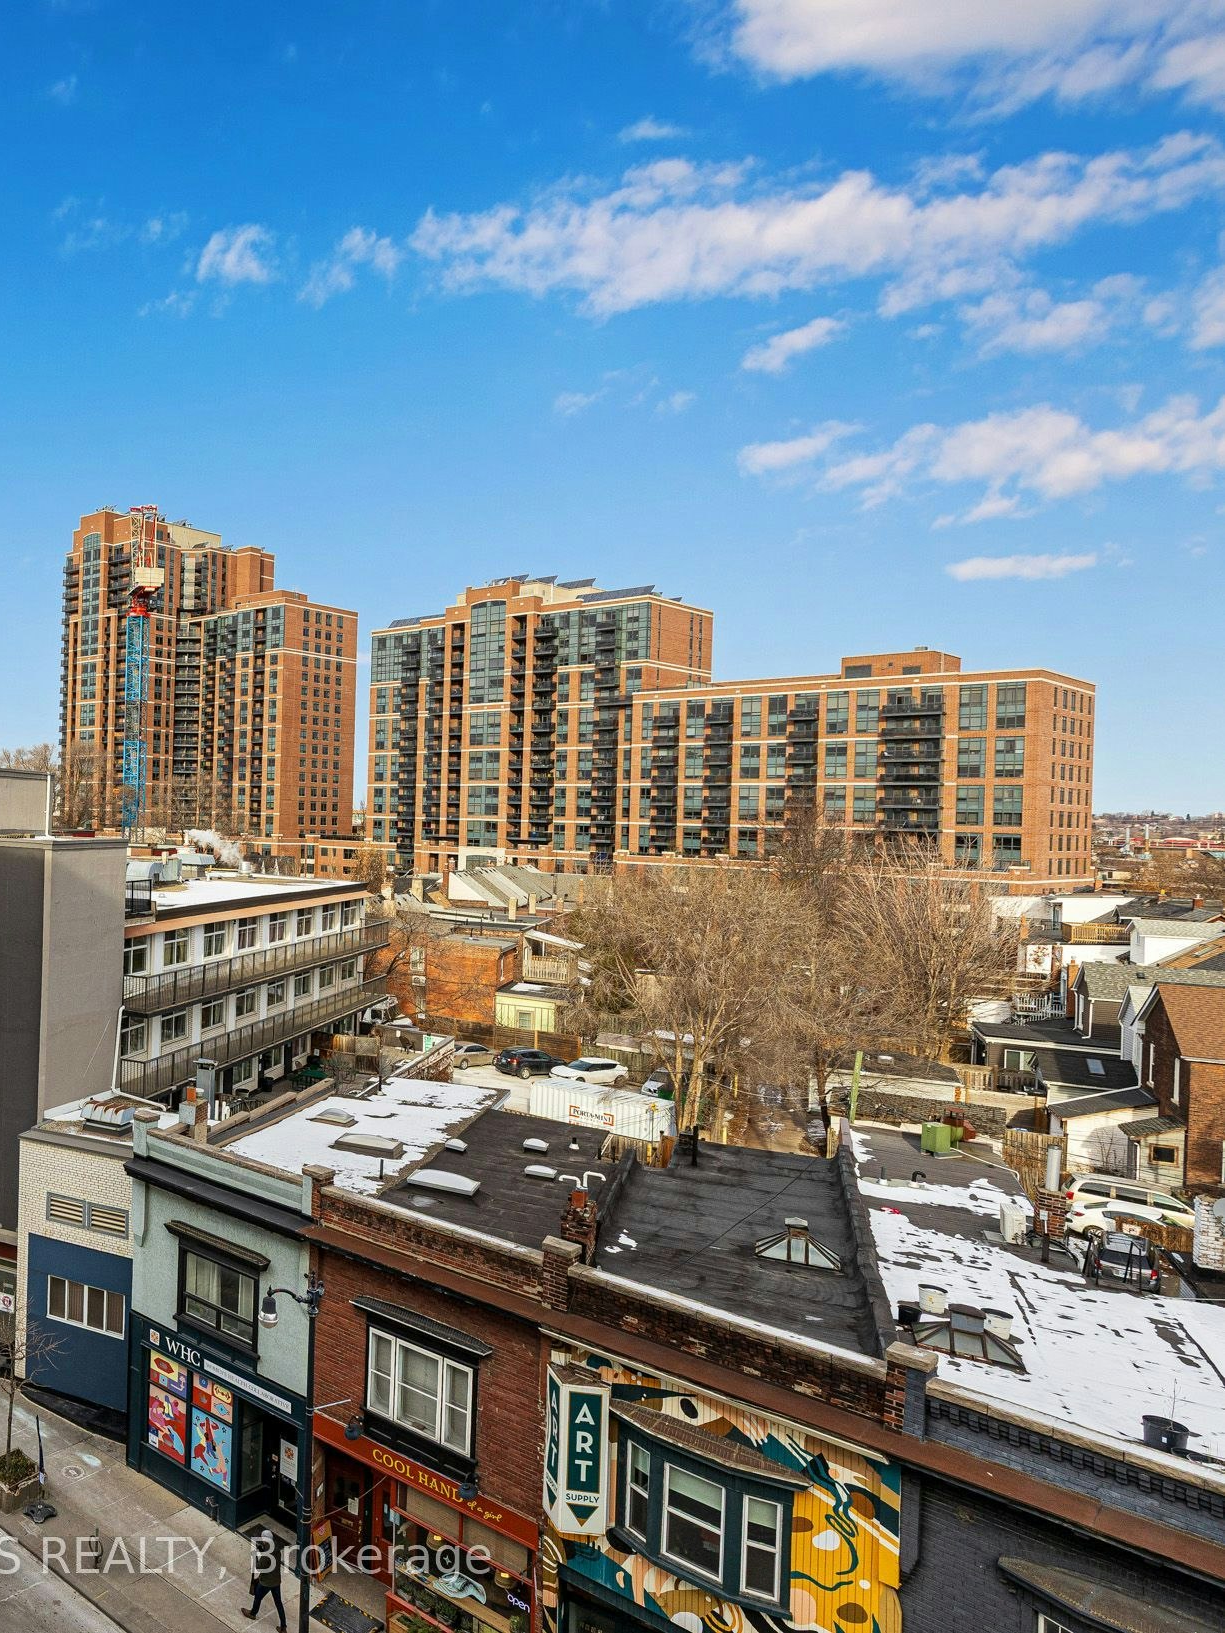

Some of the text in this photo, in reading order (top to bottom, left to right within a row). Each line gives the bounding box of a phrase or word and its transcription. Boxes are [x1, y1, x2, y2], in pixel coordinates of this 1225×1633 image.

[165, 1336, 201, 1367] WHC
[574, 1402, 596, 1482] ART
[372, 1449, 415, 1480] COOL
[565, 1493, 600, 1504] SUPPLY
[507, 1594, 530, 1613] open
